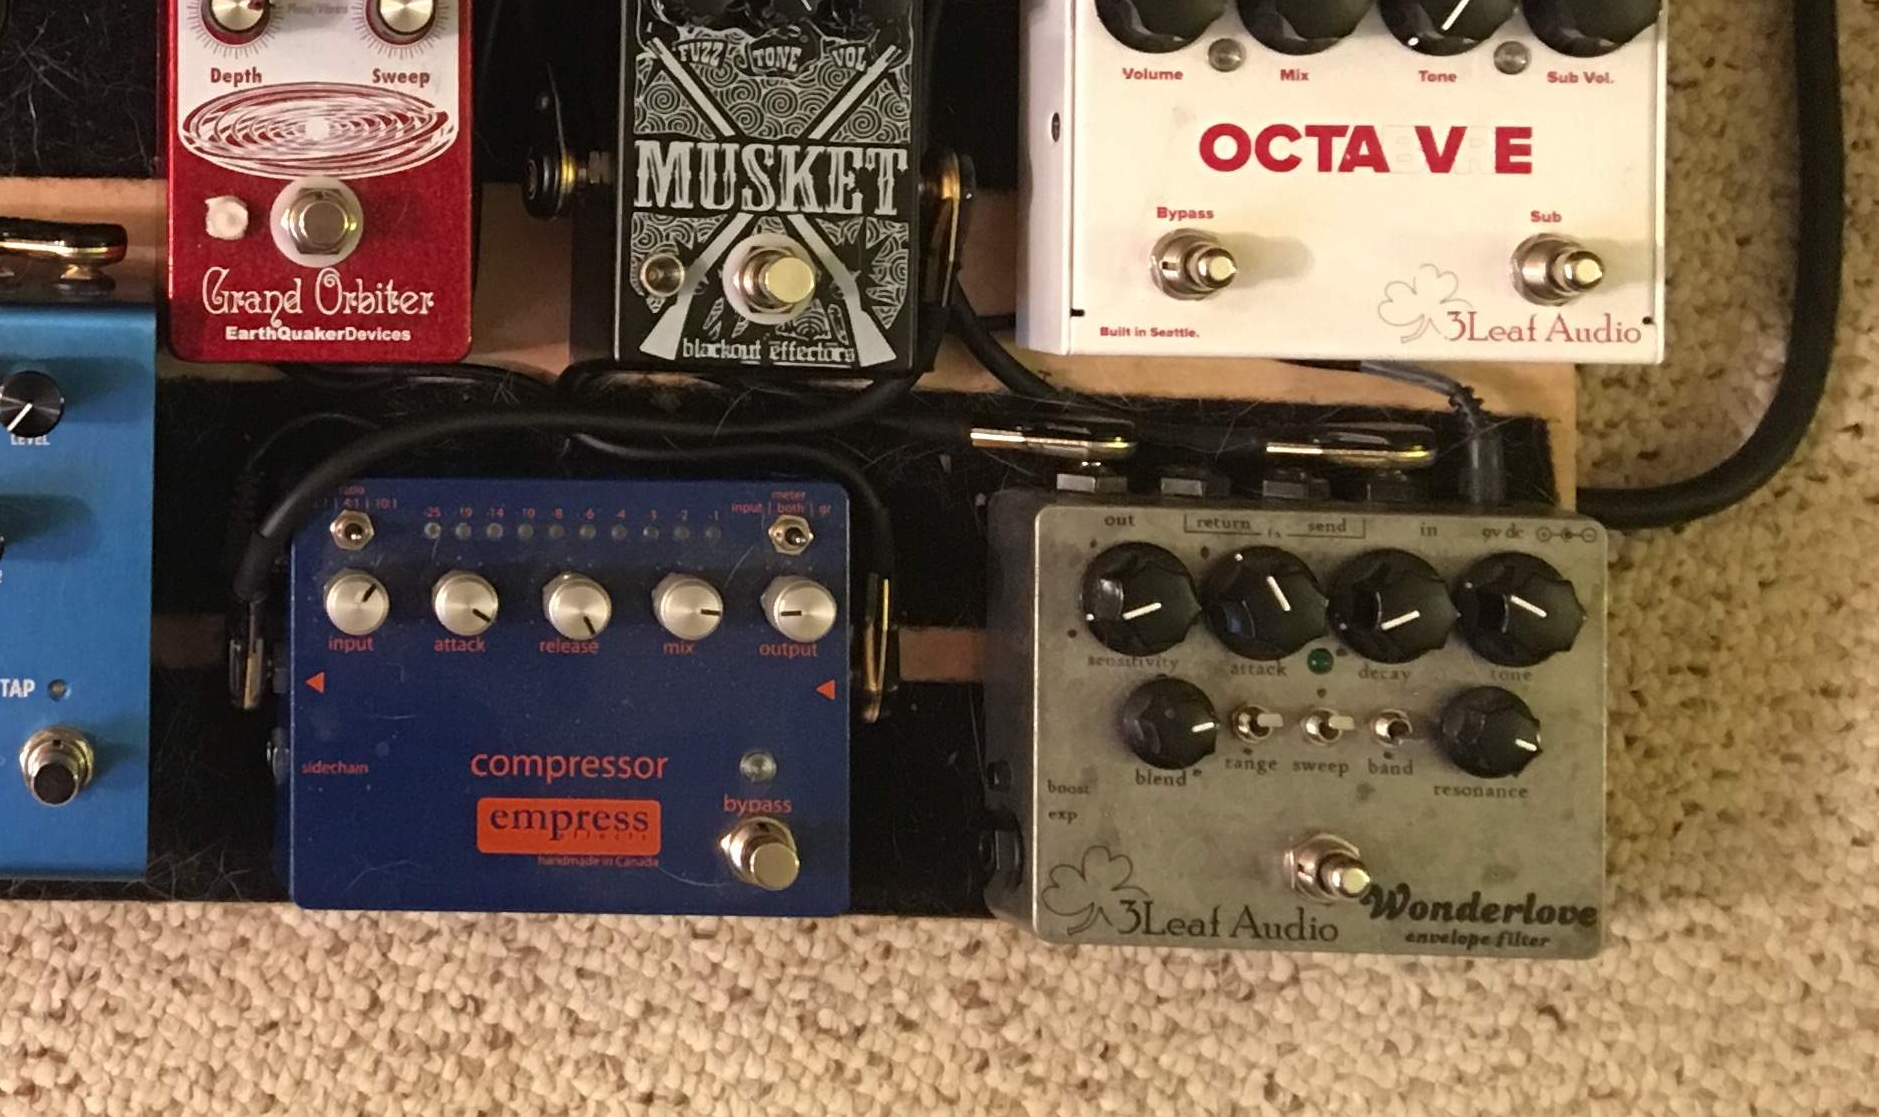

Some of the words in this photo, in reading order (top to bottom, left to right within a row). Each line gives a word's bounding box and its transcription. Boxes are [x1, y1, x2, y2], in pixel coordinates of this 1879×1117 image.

[678, 42, 724, 67] FUZZ
[752, 46, 802, 71] TONE
[832, 46, 867, 71] VOL
[210, 67, 262, 87] Depth
[372, 68, 430, 87] Sweep
[1122, 68, 1183, 82] Volume
[1280, 69, 1309, 82] Mix
[1419, 69, 1457, 83] Tone
[1547, 71, 1578, 84] Sub
[1581, 71, 1614, 84] Vol.
[633, 139, 909, 215] MUSKET
[1157, 207, 1214, 223] Bypass
[1531, 210, 1561, 223] Sub
[202, 266, 303, 328] Grand
[315, 267, 434, 315] Orbiter
[225, 326, 411, 341] EarthQuakerDevices
[1100, 327, 1130, 337] Built
[1134, 327, 1146, 336] in
[1150, 327, 1200, 338] Seattle.
[1444, 309, 1538, 343] 3Leaf
[1545, 312, 1642, 344] Audio
[682, 337, 761, 361] blackout
[770, 340, 855, 363] effectors
[1104, 514, 1135, 527] out
[1196, 517, 1250, 531] return
[1307, 519, 1347, 533] send
[1420, 523, 1438, 536] in
[328, 636, 373, 653] input
[434, 637, 485, 652] attack
[539, 638, 599, 654] release
[663, 640, 694, 655] mix
[759, 642, 818, 658] output
[1230, 661, 1287, 676] attack
[1358, 666, 1411, 683] decay
[1490, 669, 1532, 682] tone
[0, 679, 36, 699] TAP
[302, 761, 369, 775] sidechain
[470, 751, 669, 785] compressor
[1225, 757, 1277, 773] range
[1292, 758, 1349, 775] sweep
[1369, 758, 1413, 775] band
[1135, 770, 1187, 787] blend
[1048, 780, 1090, 795] boost
[1433, 784, 1528, 799] resonance
[723, 795, 792, 813] bypass
[490, 807, 649, 841] empress
[1048, 808, 1077, 824] exp
[1360, 883, 1597, 928] Wonderlove
[1118, 899, 1222, 937] 3Leaf
[1230, 906, 1339, 942] Audio
[1405, 931, 1490, 950] envelope
[1494, 931, 1550, 950] filter
